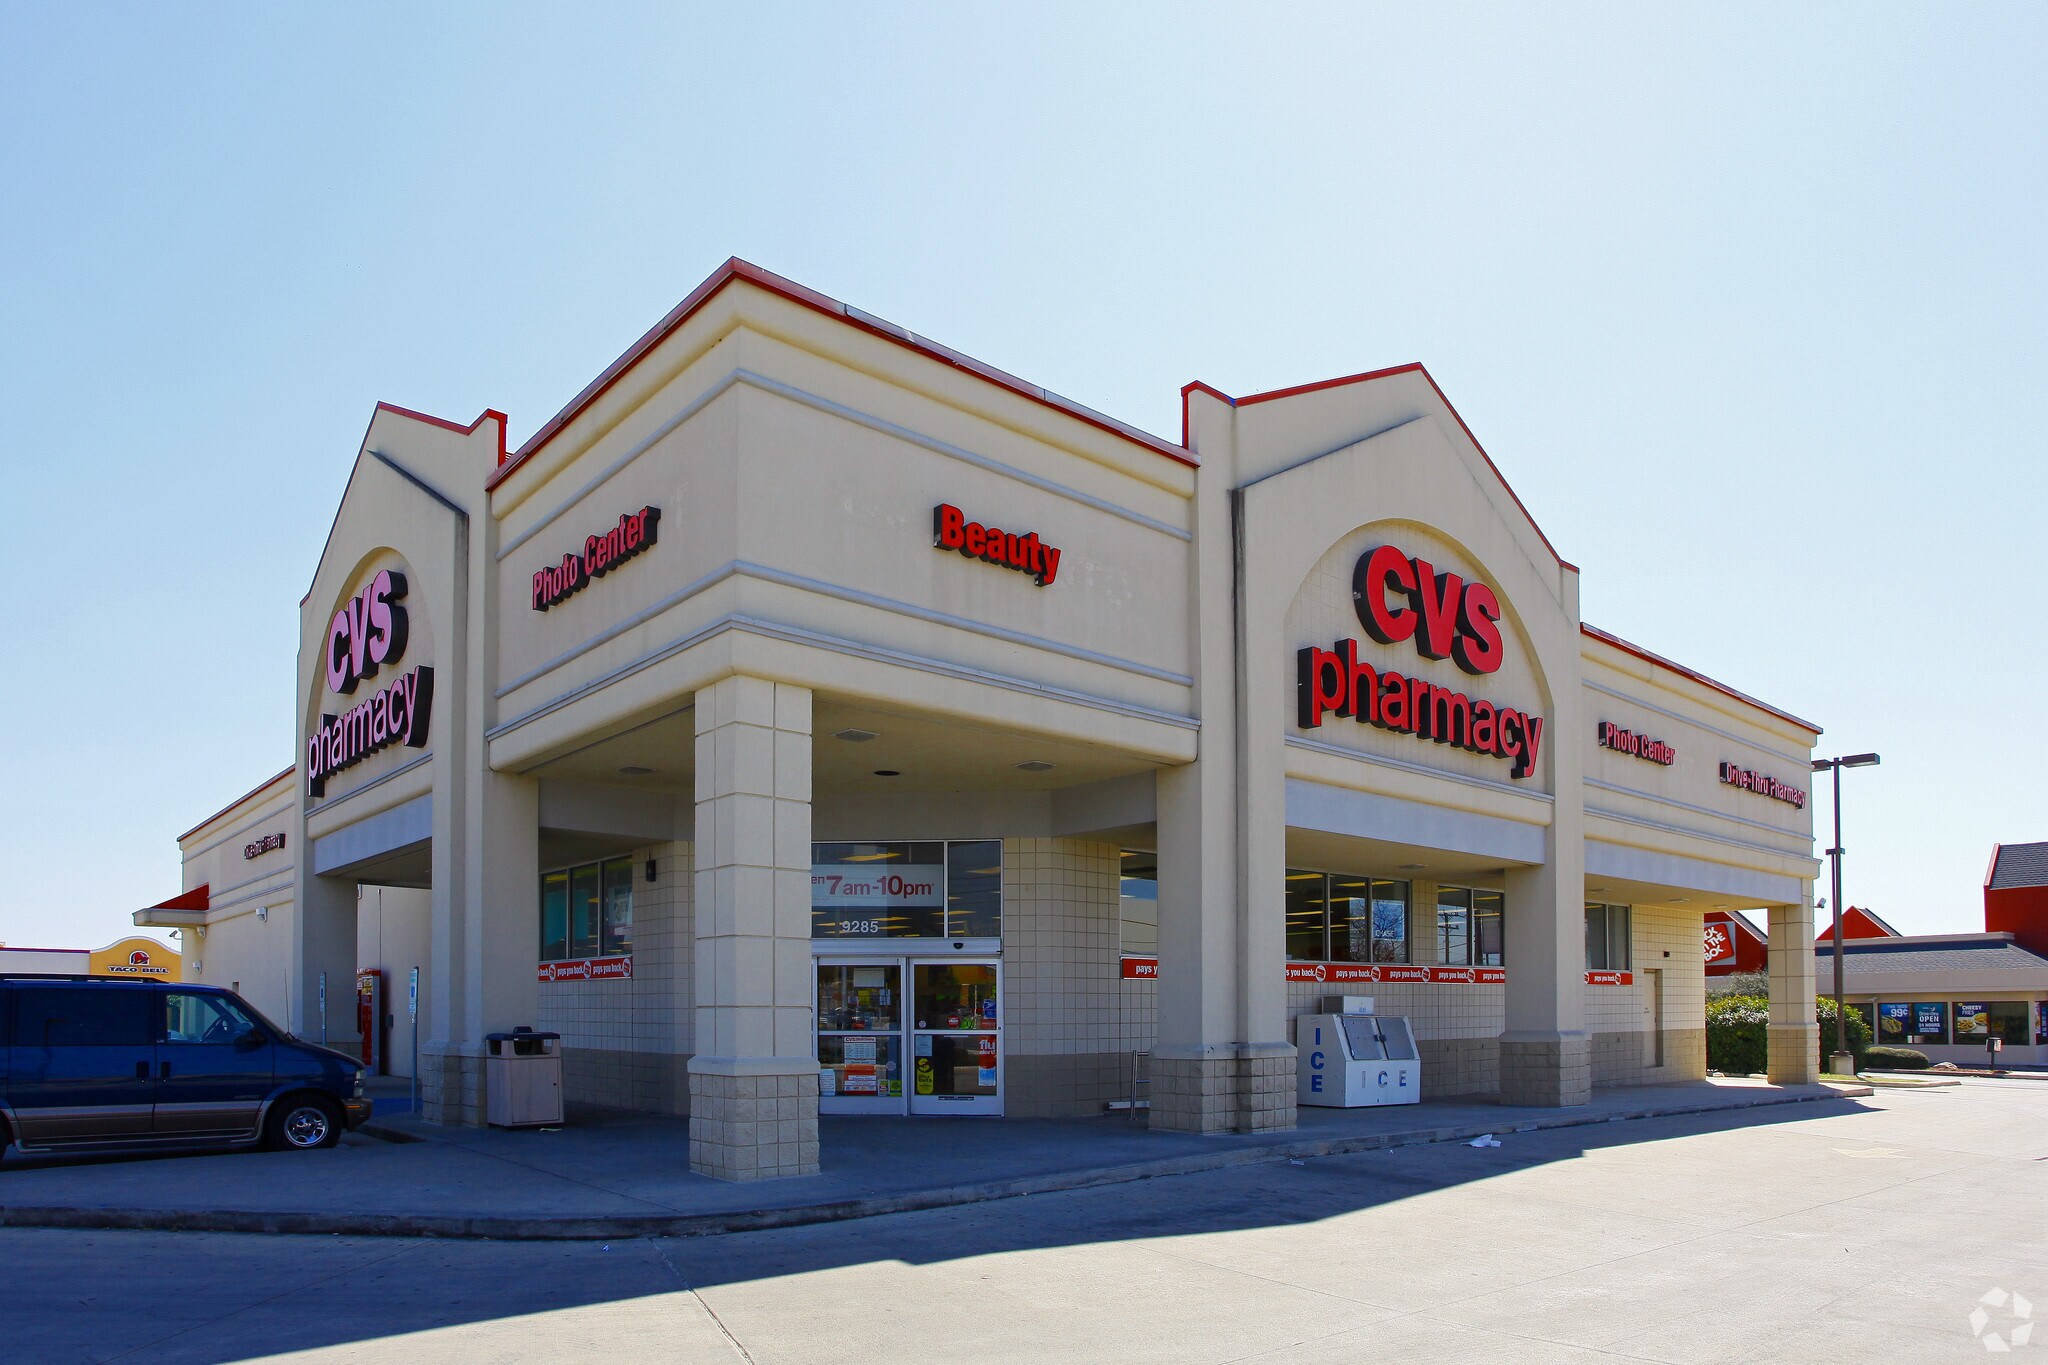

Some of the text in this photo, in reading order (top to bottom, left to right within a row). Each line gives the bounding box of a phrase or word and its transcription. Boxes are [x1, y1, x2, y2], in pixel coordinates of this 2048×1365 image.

[532, 506, 658, 611] Photo Center
[936, 503, 1061, 586] Beauty
[1353, 545, 1503, 675] CVS
[327, 570, 407, 694] CVS
[1298, 638, 1543, 779] pharmacy
[308, 665, 434, 797] pharmacy
[1600, 722, 1676, 765] Photo Center
[1722, 762, 1807, 809] Drive-Thru Pharmacy
[842, 921, 879, 933] 9285
[1136, 965, 1152, 975] pays
[1291, 970, 1300, 978] you
[1336, 970, 1348, 979] pays
[1349, 970, 1358, 978] you
[1390, 970, 1401, 979] pays
[1401, 971, 1410, 979] you
[1890, 1008, 1908, 1018] 99¢
[1919, 1015, 1940, 1023] OPEN
[980, 1039, 996, 1050] flu
[1310, 1028, 1325, 1093] ICE
[1361, 1070, 1407, 1089] ICE
